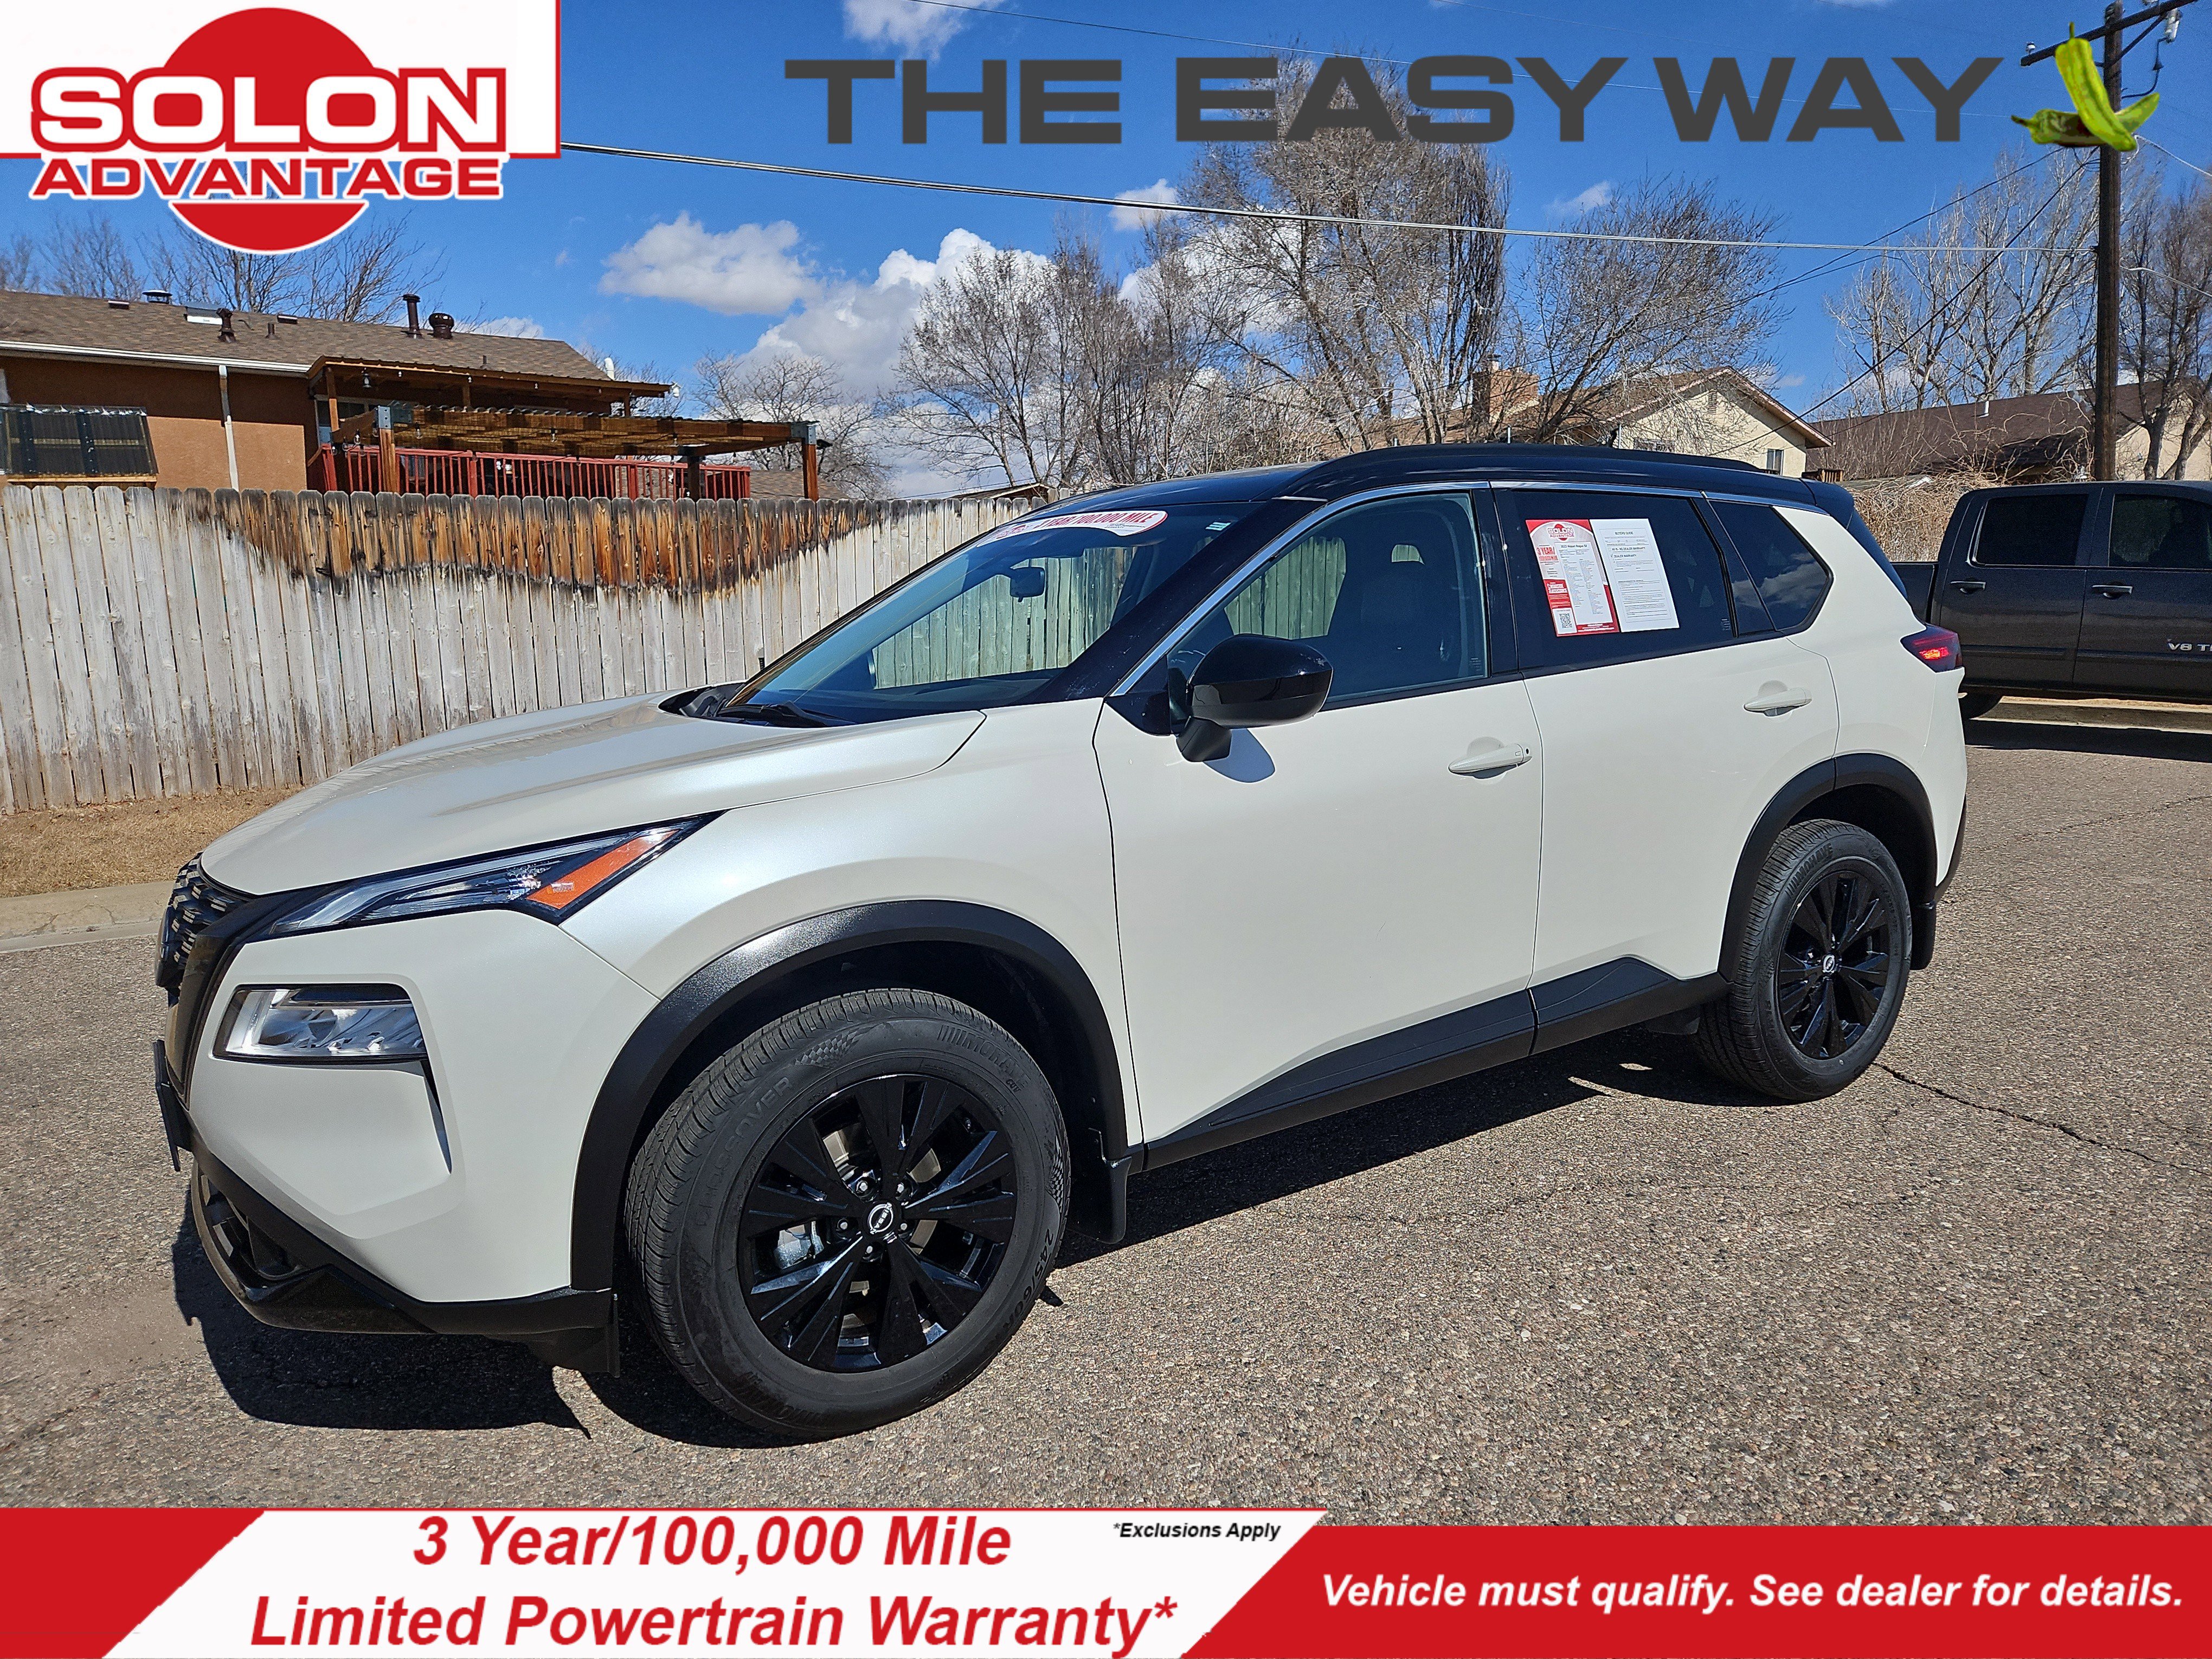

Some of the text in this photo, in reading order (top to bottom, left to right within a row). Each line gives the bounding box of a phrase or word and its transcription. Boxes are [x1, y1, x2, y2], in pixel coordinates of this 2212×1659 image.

[1033, 519, 1051, 530] 3
[1117, 512, 1159, 523] MILE
[1536, 547, 1541, 555] 3
[2168, 642, 2192, 651] V8
[870, 1202, 892, 1235] NISSAN
